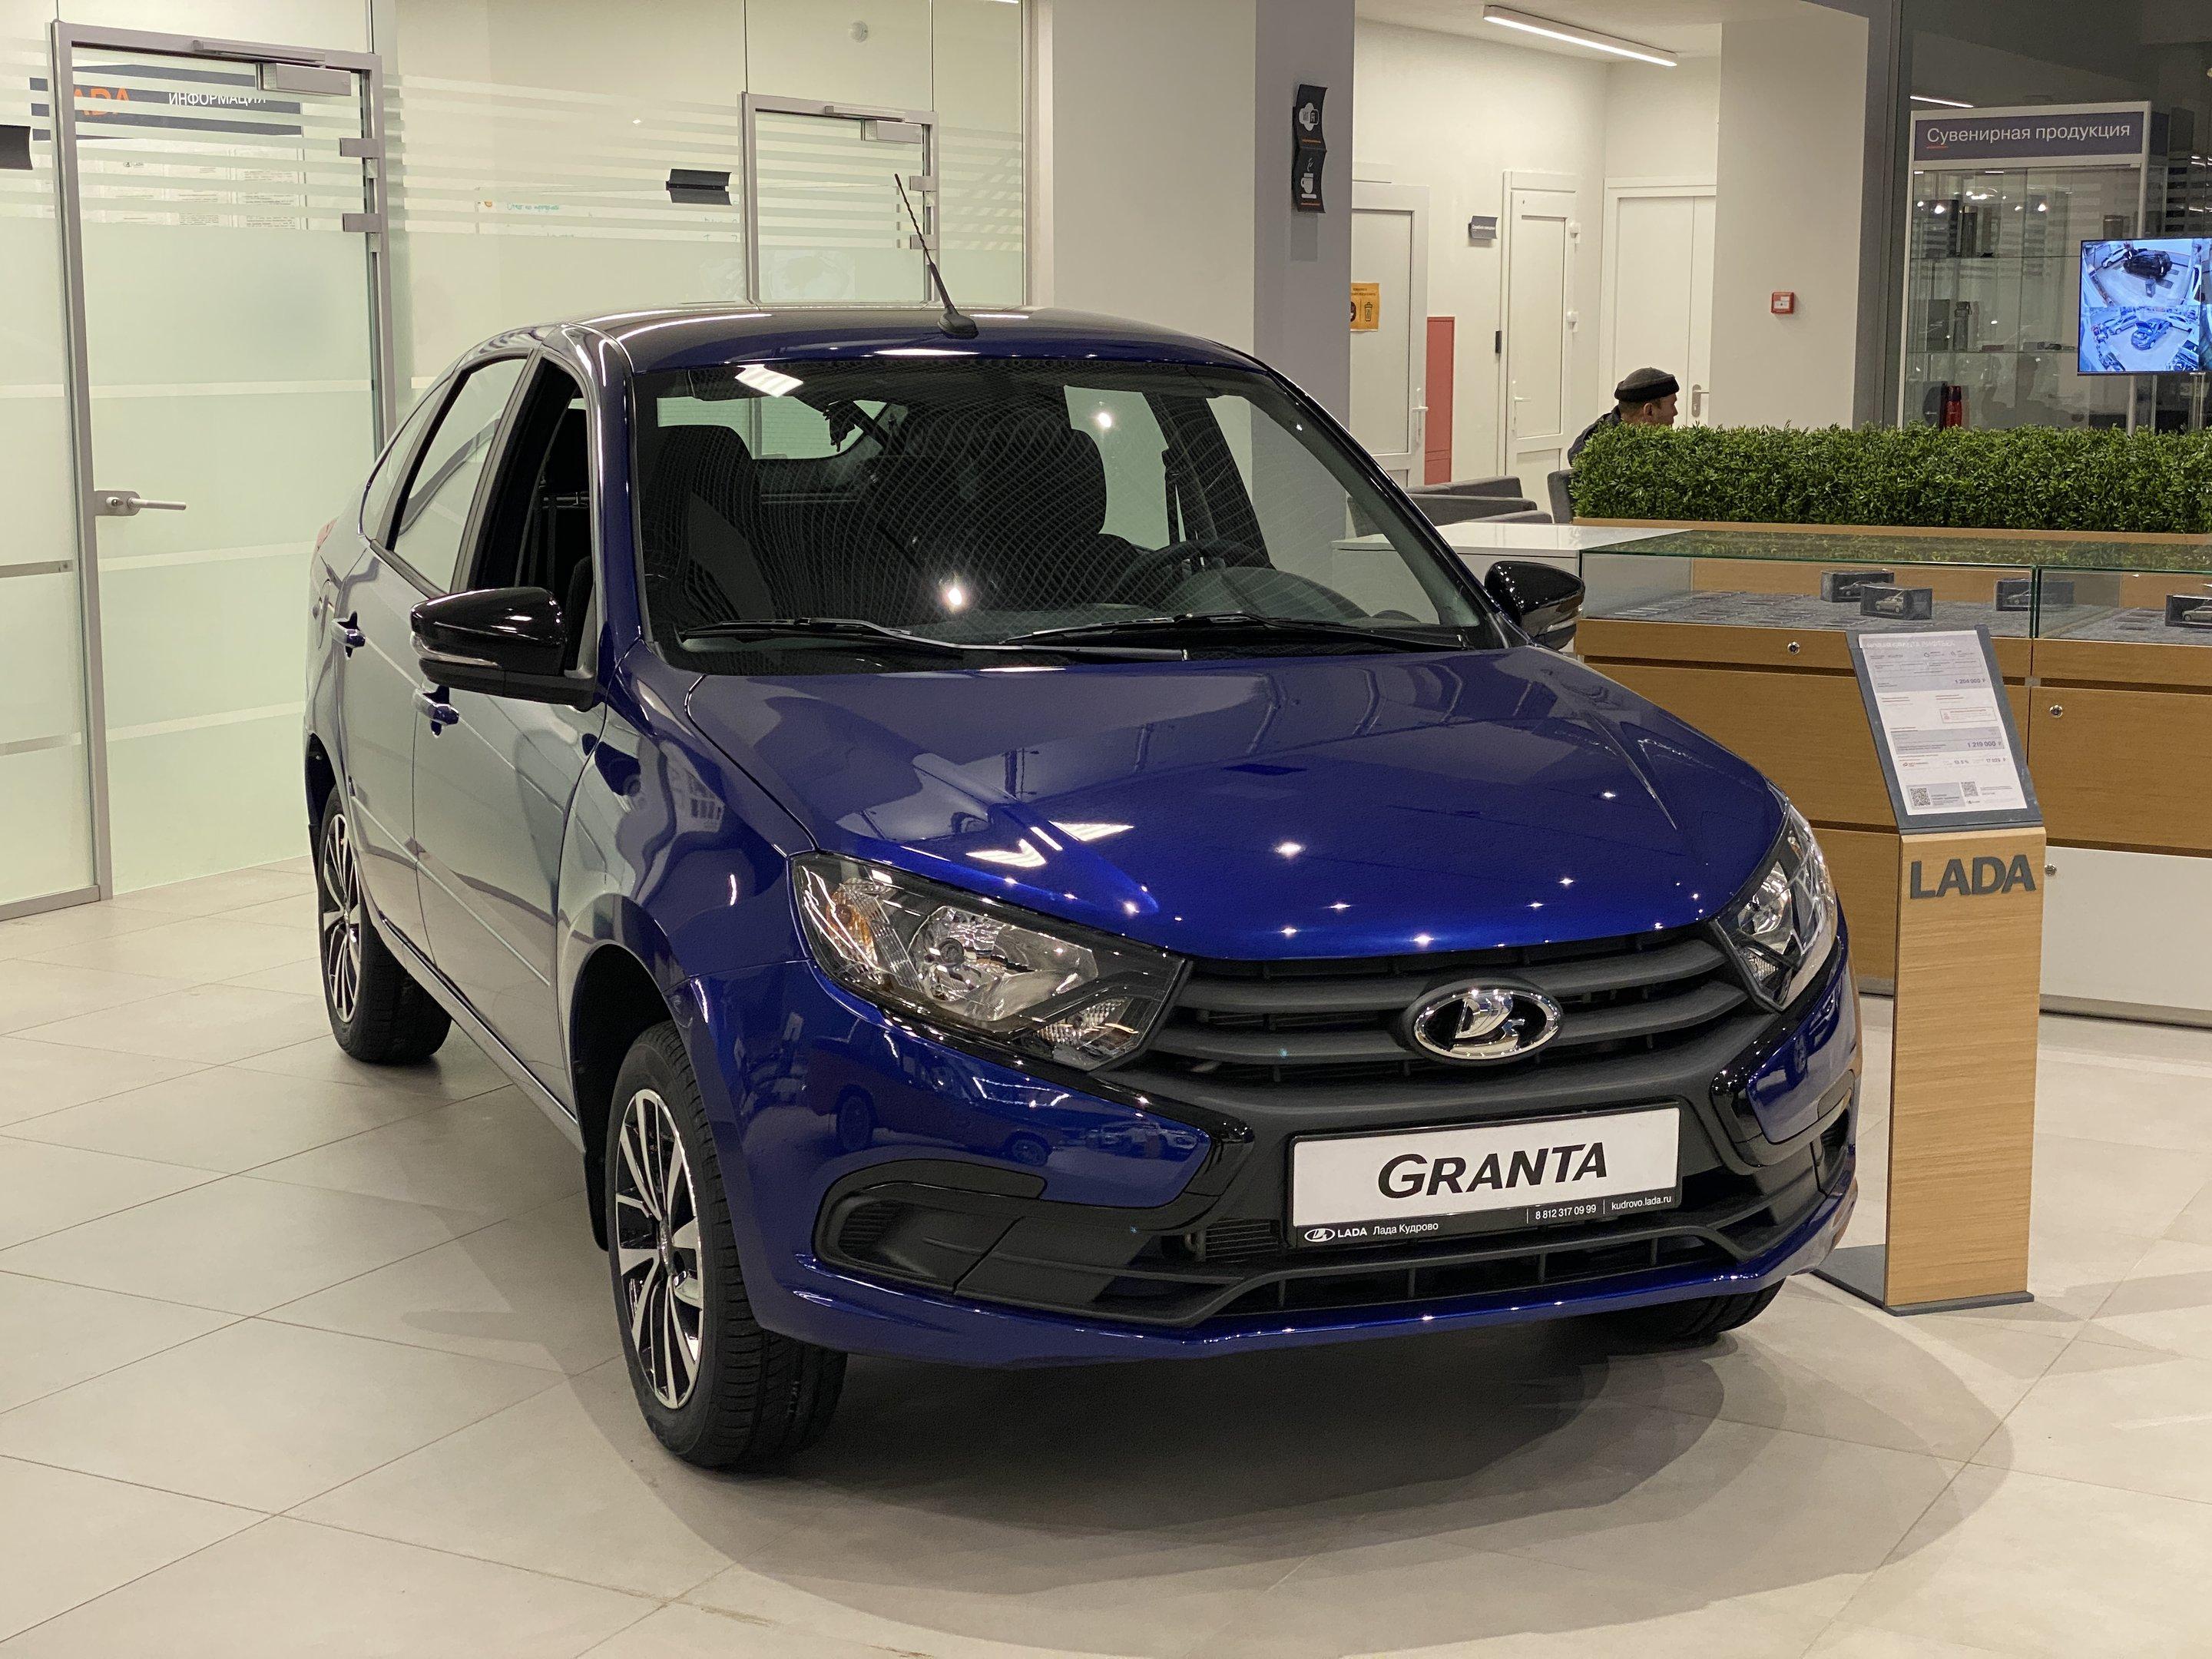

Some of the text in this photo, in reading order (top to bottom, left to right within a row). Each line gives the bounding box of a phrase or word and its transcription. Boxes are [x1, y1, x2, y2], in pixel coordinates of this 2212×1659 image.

[1926, 124, 2131, 145] Сувенирная продукция
[1910, 854, 2037, 899] LADA
[1378, 1142, 1607, 1199] GRANTA
[1611, 1196, 1672, 1210] kudrovo.lada.ru
[1535, 1204, 1597, 1220] 8 812 317 09 99
[1337, 1227, 1368, 1238] LADA
[1373, 1223, 1439, 1236] Лада Кудрово
